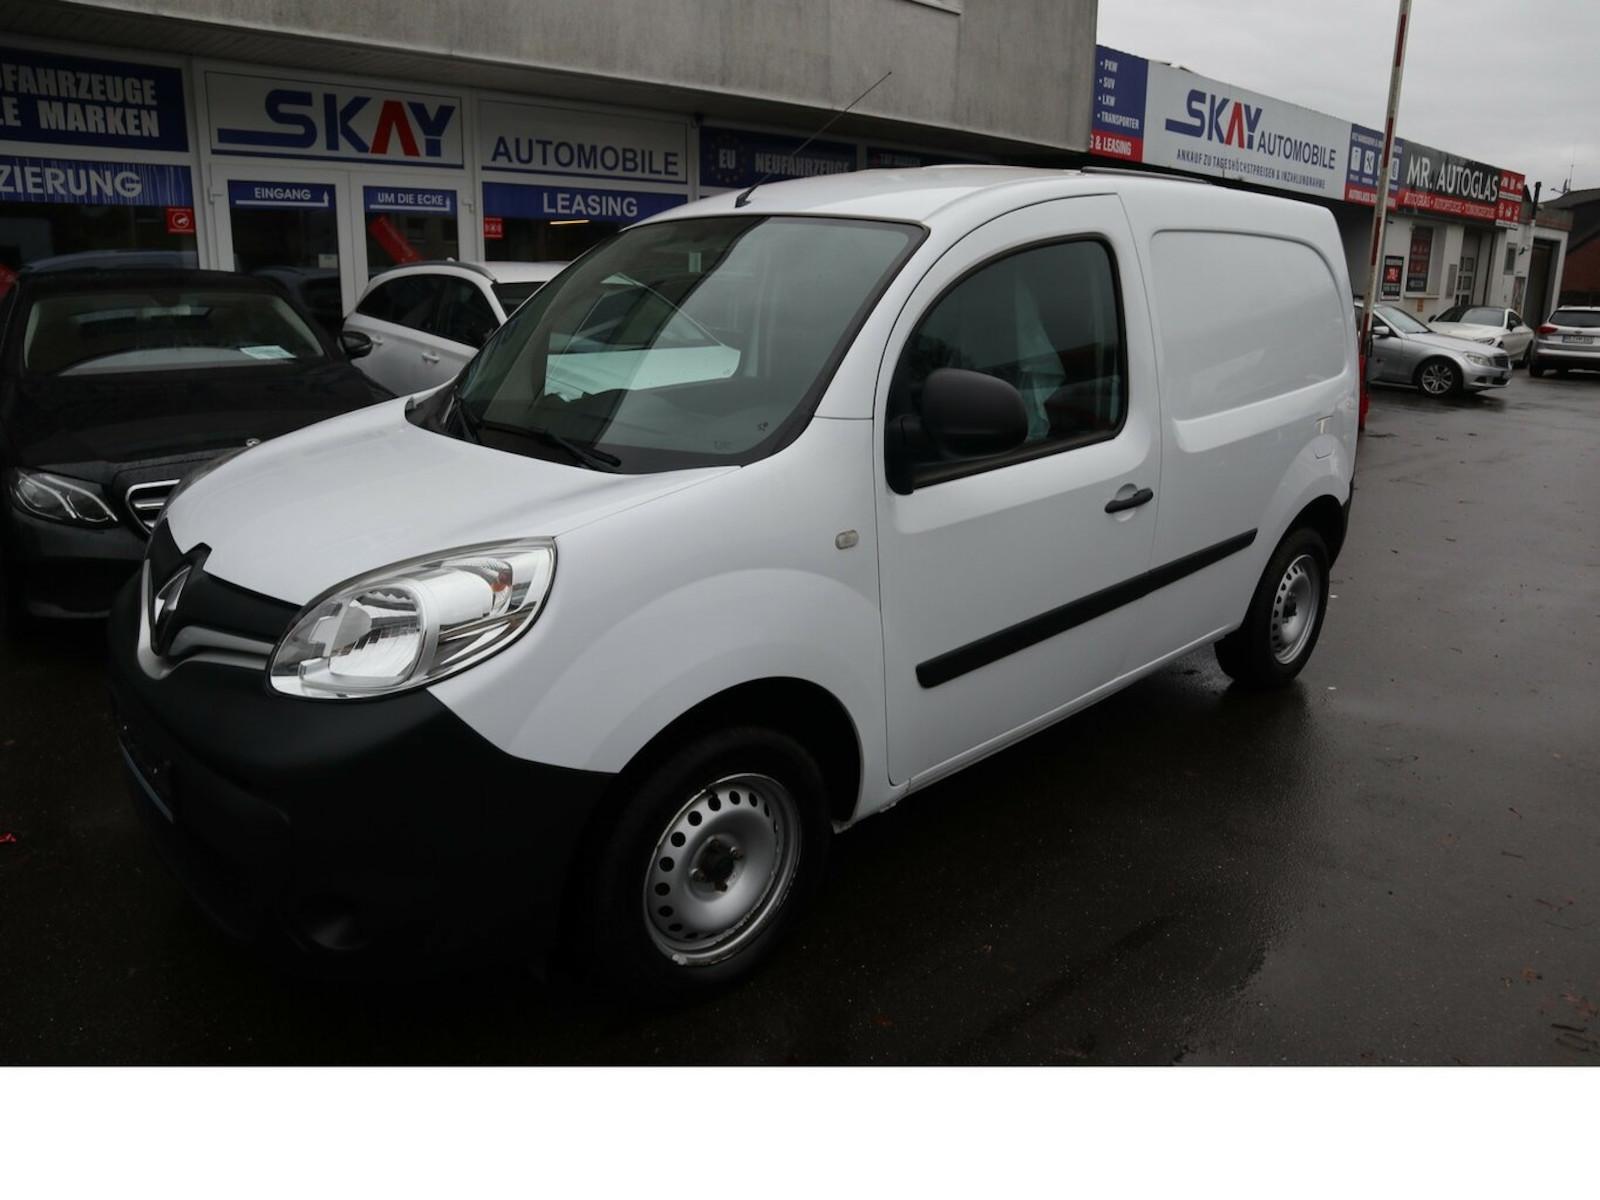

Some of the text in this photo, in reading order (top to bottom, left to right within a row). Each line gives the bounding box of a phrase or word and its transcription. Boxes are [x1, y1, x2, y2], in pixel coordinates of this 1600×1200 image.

[1104, 59, 1118, 73] PKW
[0, 63, 157, 106] FAHRZEUGE
[1103, 77, 1116, 90] SUV
[1102, 94, 1116, 106] LKW
[37, 99, 160, 138] MARKEN
[217, 88, 455, 158] SKAY
[1101, 111, 1140, 130] TRANSPORTER
[1165, 88, 1262, 150] SKAY
[490, 136, 679, 177] AUTOMOBILE
[1103, 137, 1132, 156] LEASING
[1176, 149, 1202, 164] ANKAUF
[1203, 154, 1212, 166] ZU
[1256, 131, 1337, 171] AUTOMOBILE
[719, 149, 737, 170] EU
[0, 165, 143, 198] ZIERUNG
[1406, 153, 1499, 202] MR. AUTOGLAS
[254, 187, 312, 201] EINGANG
[378, 192, 444, 205] UM DIE ECKE
[543, 193, 638, 217] LEASING
